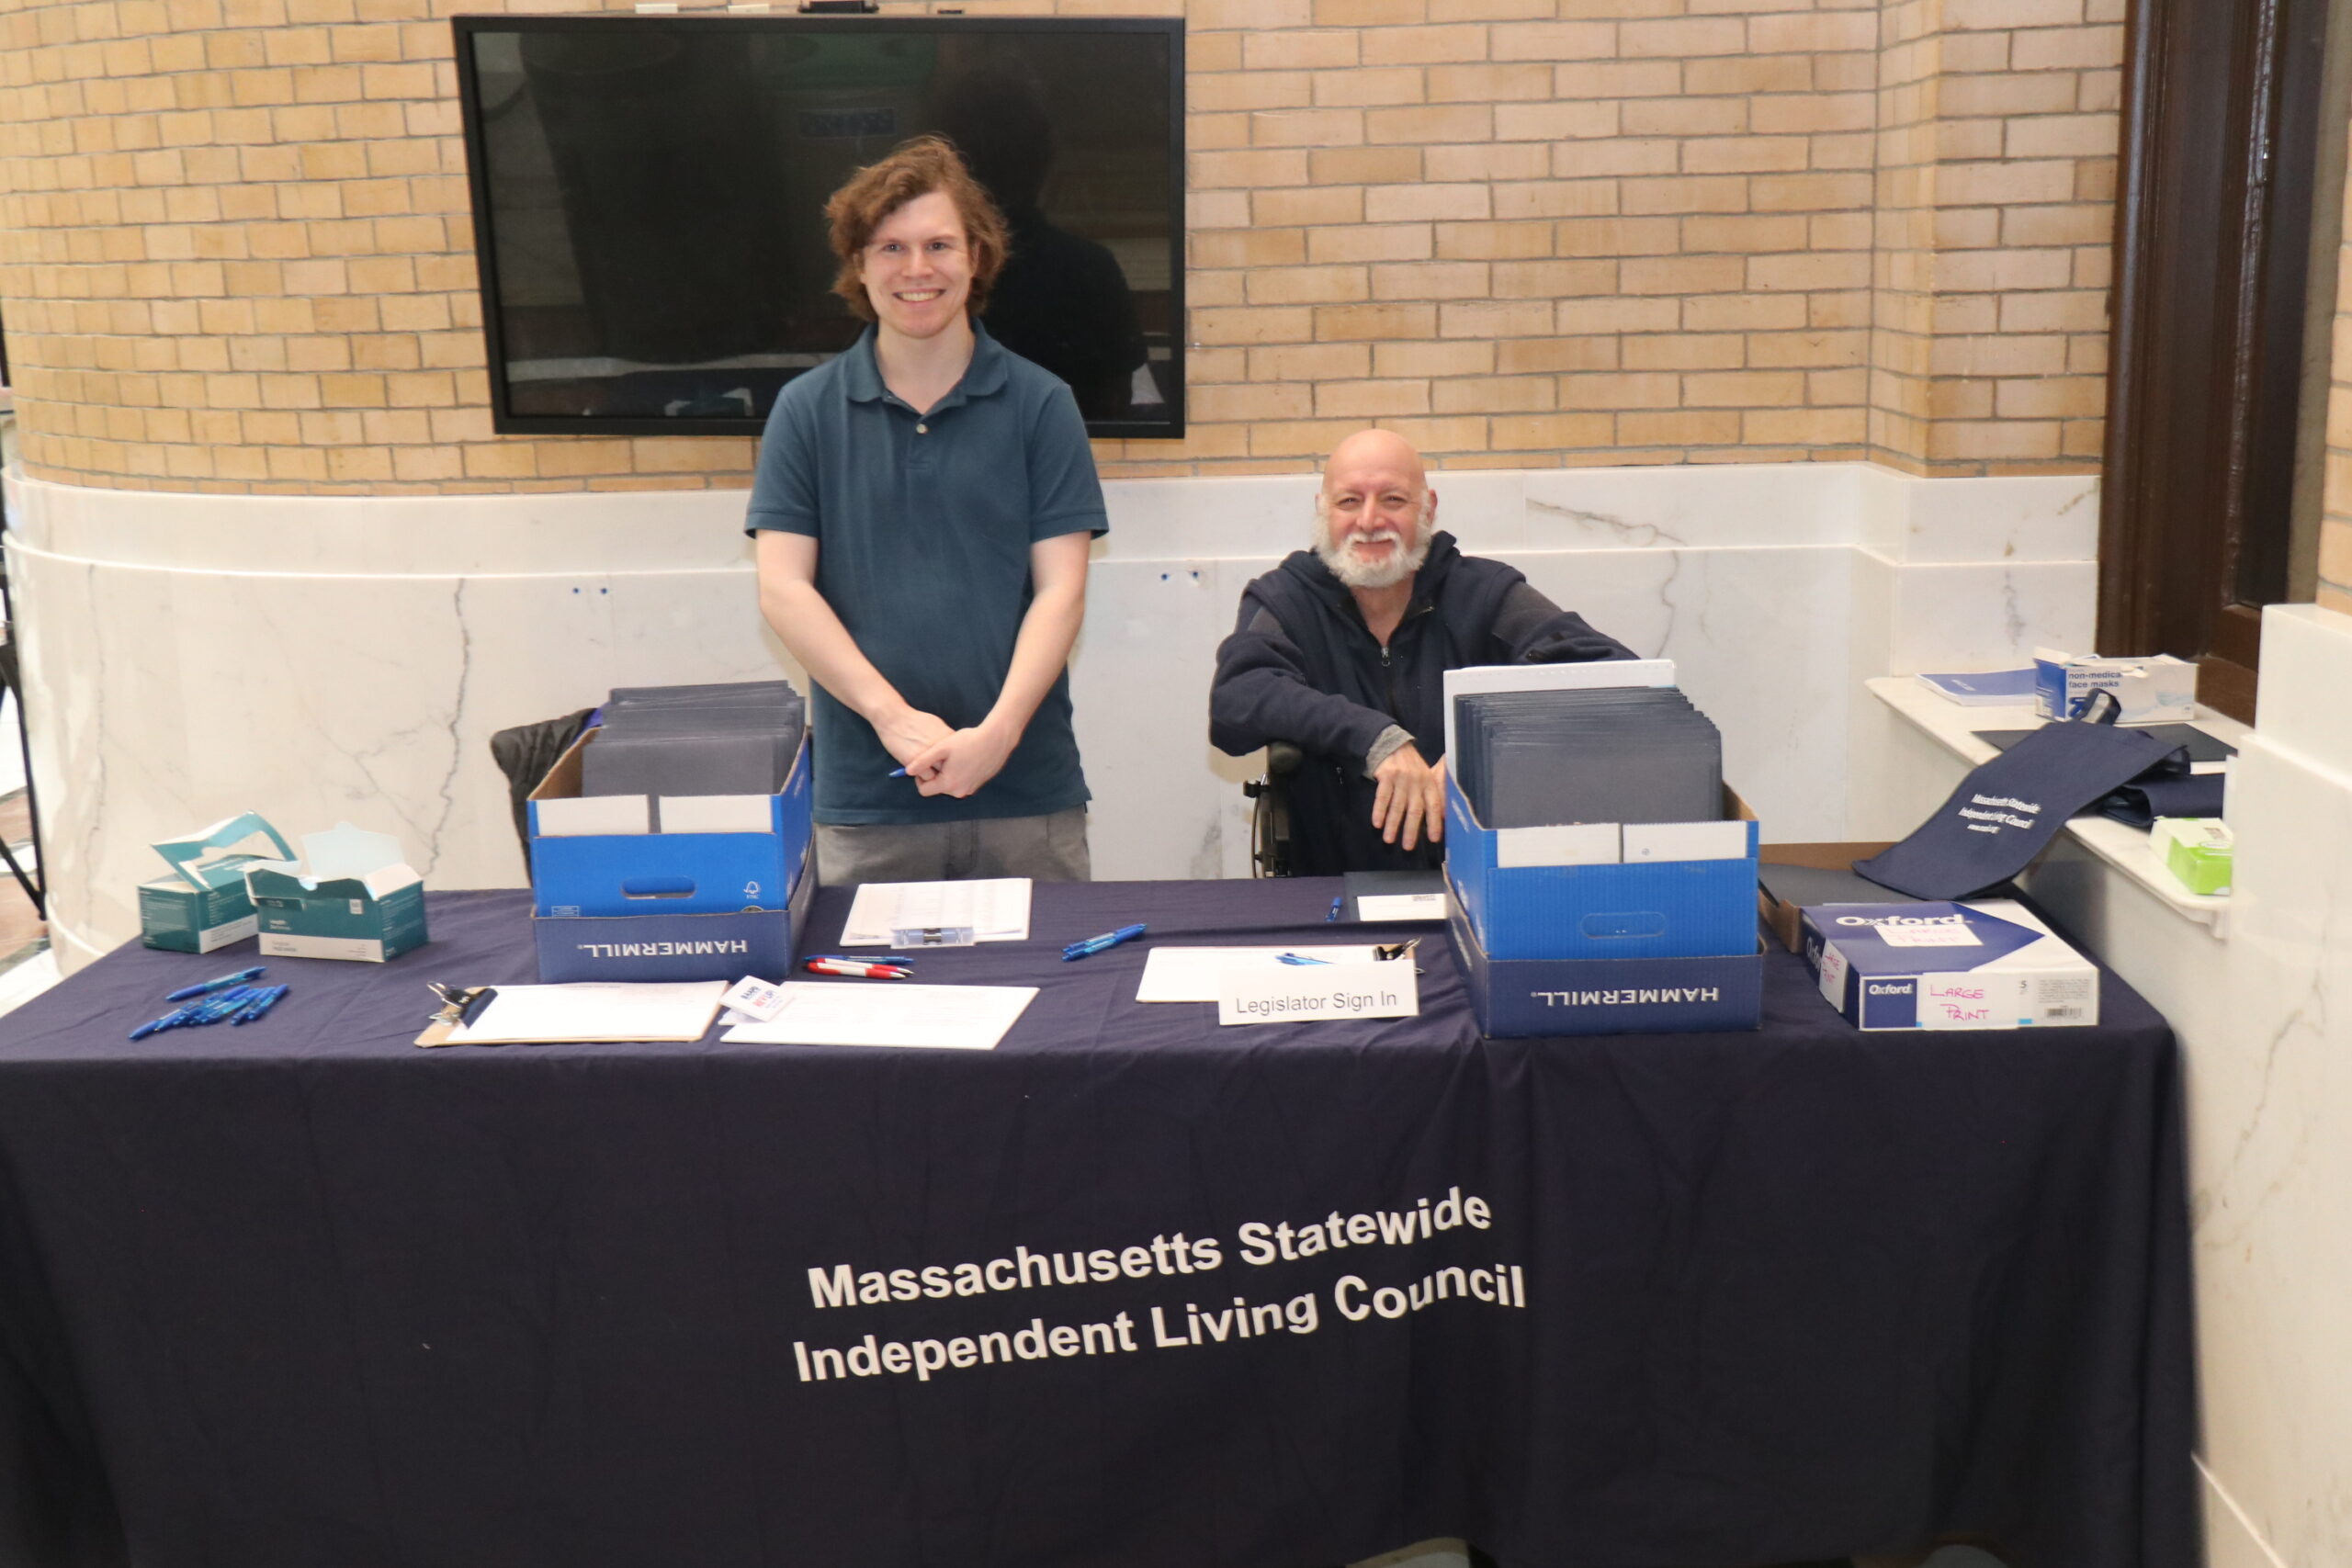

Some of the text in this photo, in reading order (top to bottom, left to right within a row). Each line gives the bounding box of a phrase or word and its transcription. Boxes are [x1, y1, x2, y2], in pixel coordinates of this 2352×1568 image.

[2068, 671, 2121, 680] non-medica
[1836, 914, 1965, 926] Oxford
[582, 940, 748, 958] HAMMERMILL
[1536, 987, 1720, 1007] HAMMERMILL
[1869, 983, 1913, 995] Oxford
[1930, 985, 1984, 998] LARGE
[1236, 990, 1397, 1017] Legislator Sign In
[1939, 1003, 1990, 1021] PRINT
[808, 1186, 1491, 1309] Massachusetts Statewide
[793, 1264, 1524, 1382] Independent Living Council
